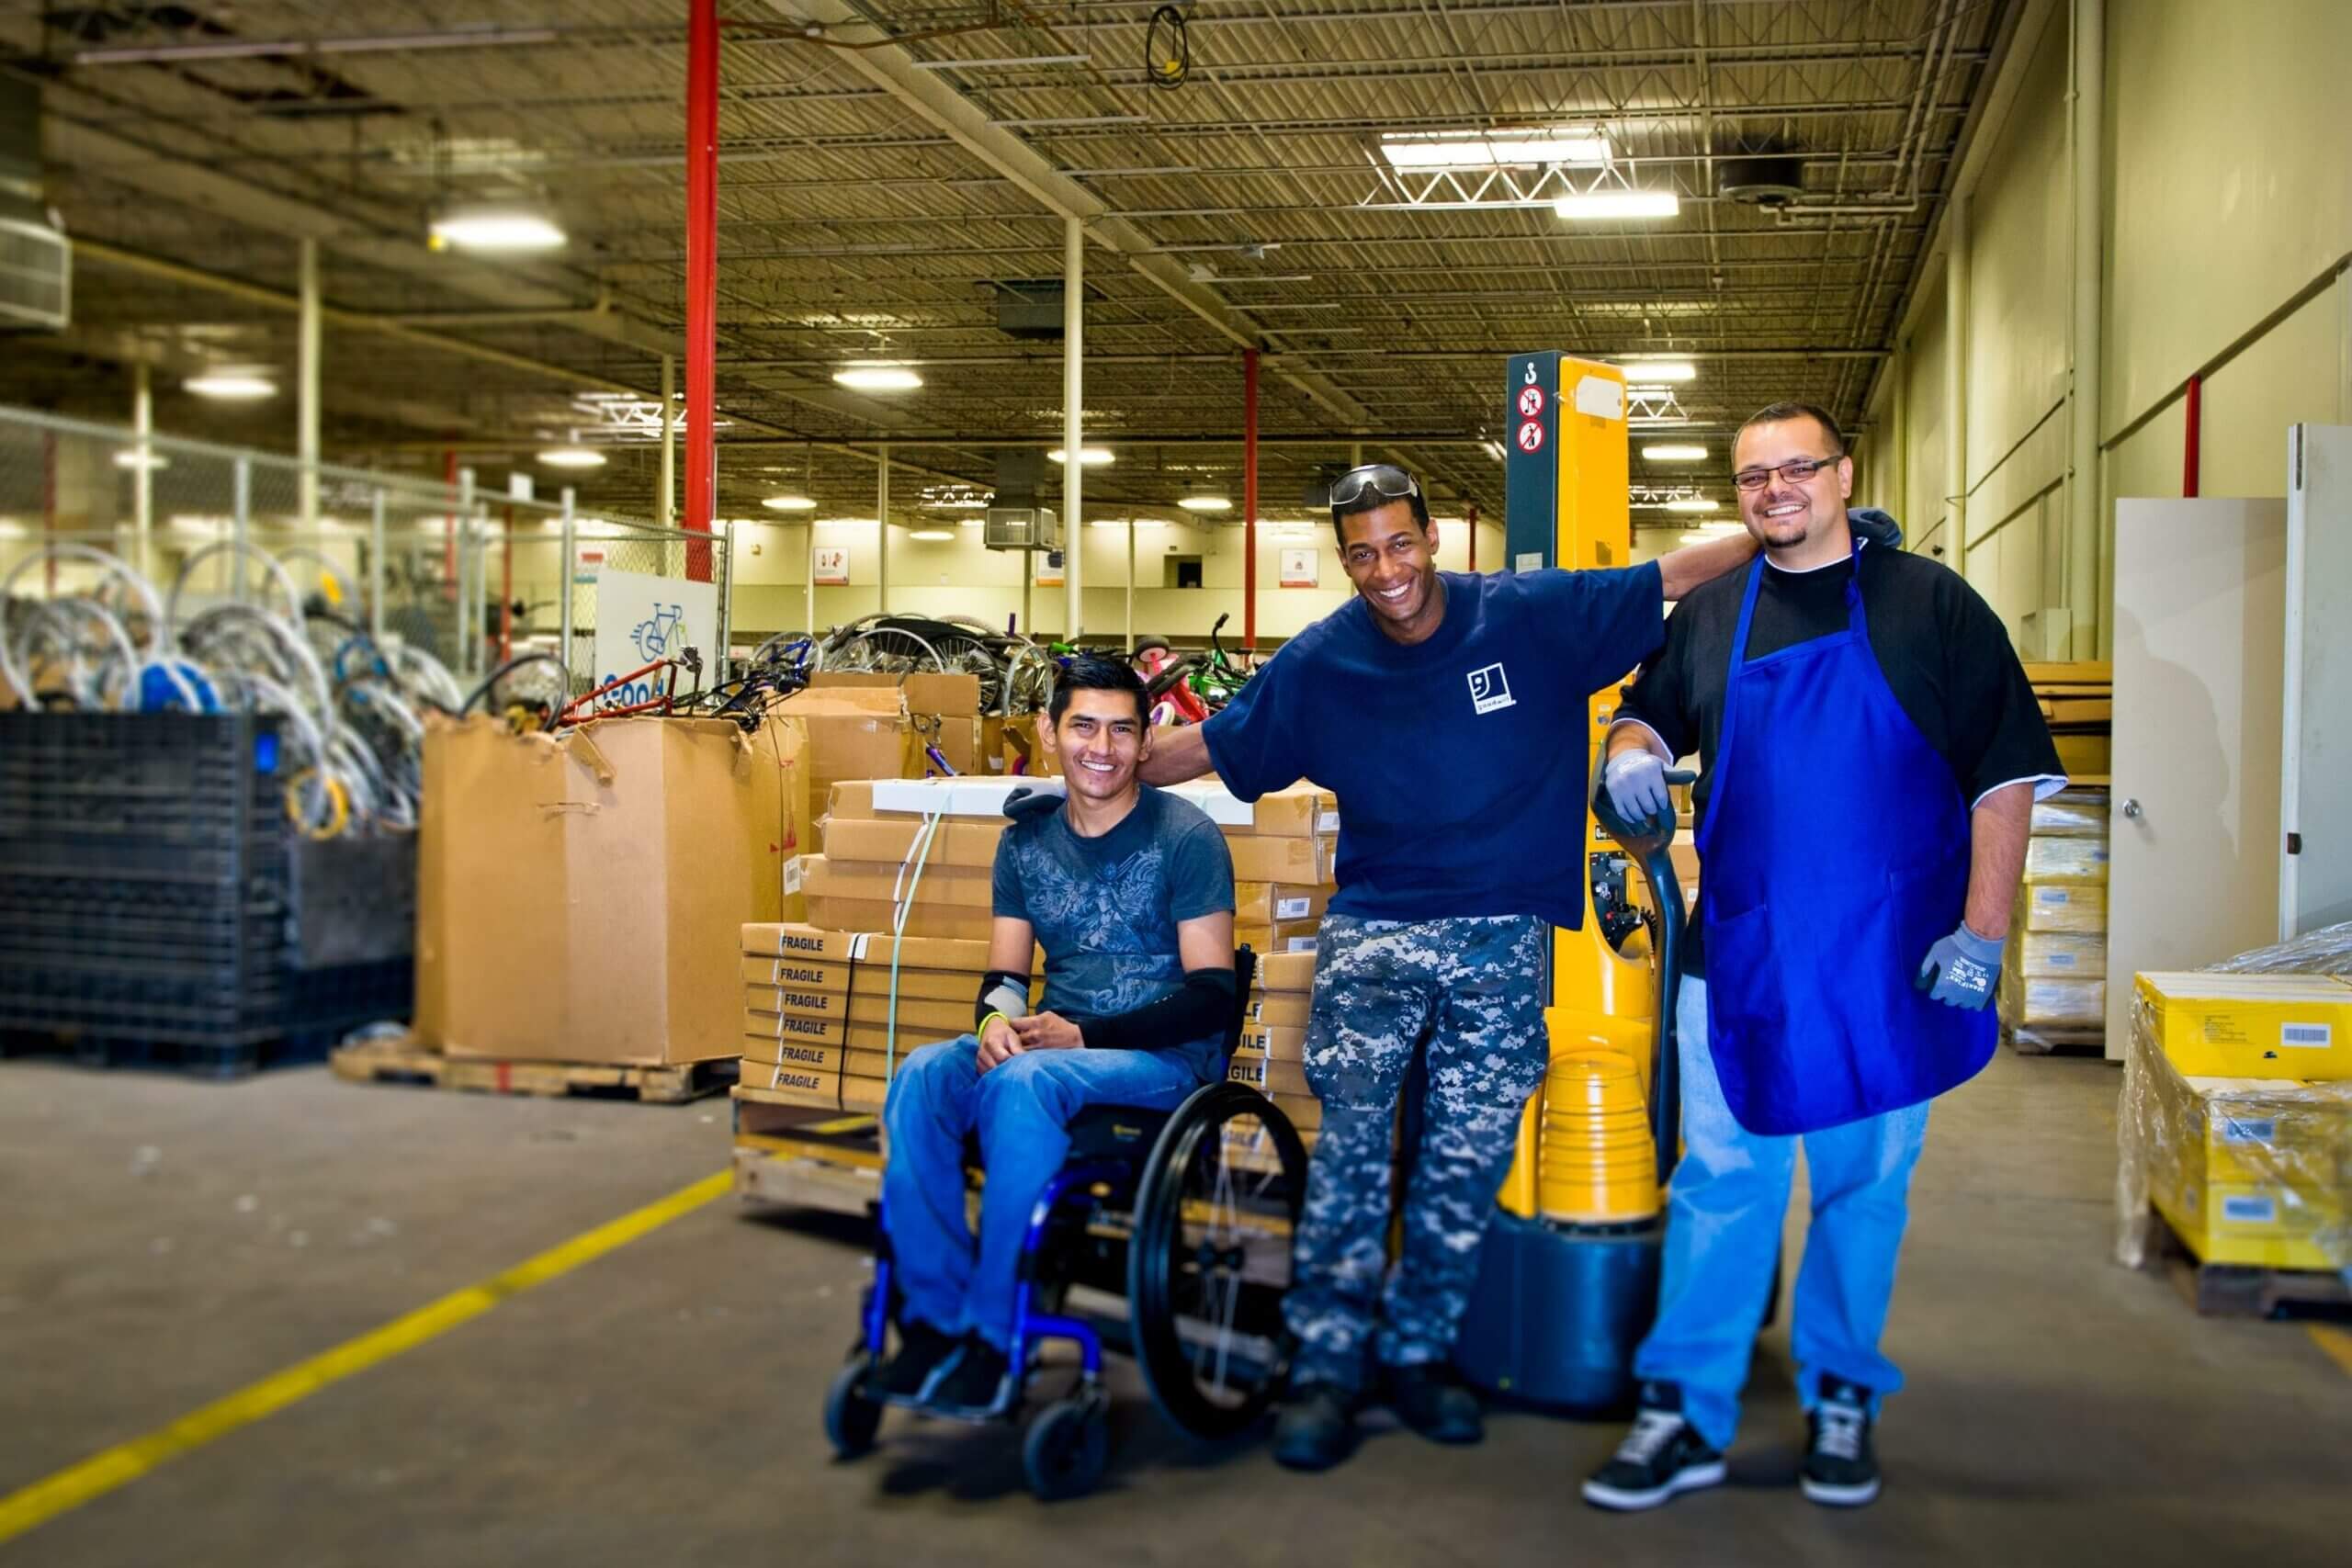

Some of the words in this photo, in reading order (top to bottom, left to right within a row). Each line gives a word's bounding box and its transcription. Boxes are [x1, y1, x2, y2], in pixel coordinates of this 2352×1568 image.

[781, 935, 824, 952] FRAGILE
[780, 968, 824, 983] FRAGILE
[785, 993, 828, 1010] FRAGILE
[783, 1020, 827, 1035] FRAGILE
[781, 1046, 824, 1063] FRAGILE
[777, 1073, 820, 1089] FRAGILE
[1229, 1065, 1263, 1082] GILE
